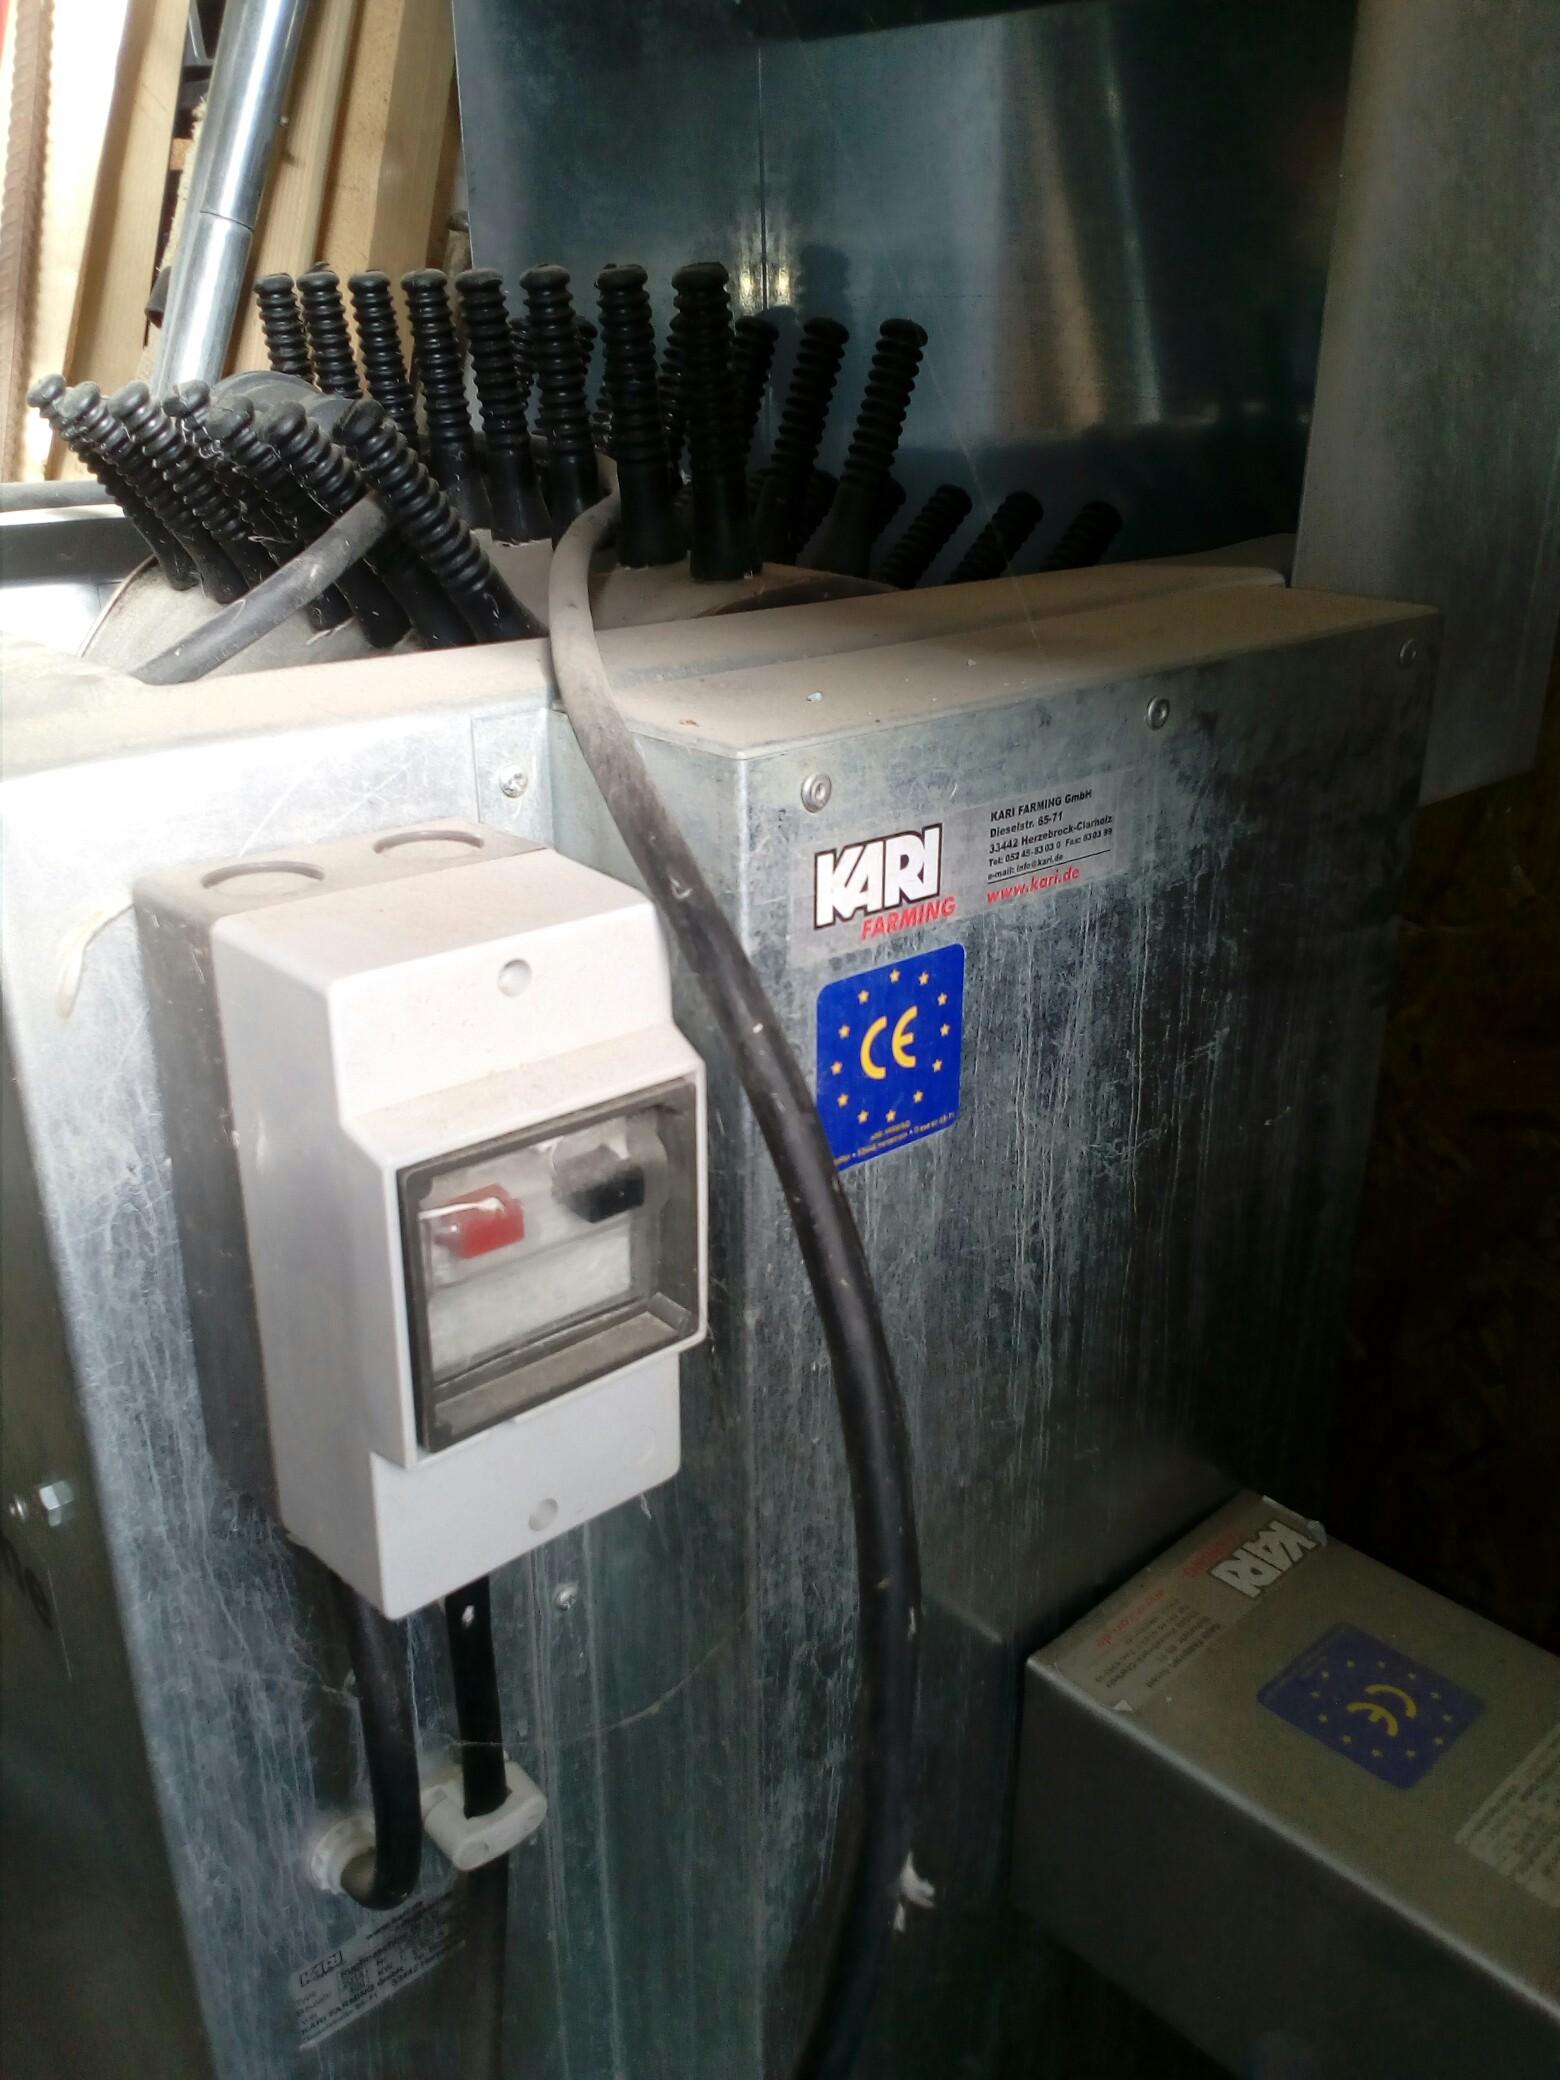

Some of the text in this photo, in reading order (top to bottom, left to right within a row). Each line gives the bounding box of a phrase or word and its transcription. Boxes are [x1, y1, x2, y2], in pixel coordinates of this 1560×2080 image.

[990, 789, 1093, 823] KARI FARMING GmbH
[989, 838, 1019, 854] 33442
[990, 820, 1034, 838] Dieselstr.
[814, 823, 943, 930] KARI
[986, 866, 1081, 905] www.kari.de
[860, 896, 957, 940] FARMING
[1207, 1519, 1320, 1598] KARI
